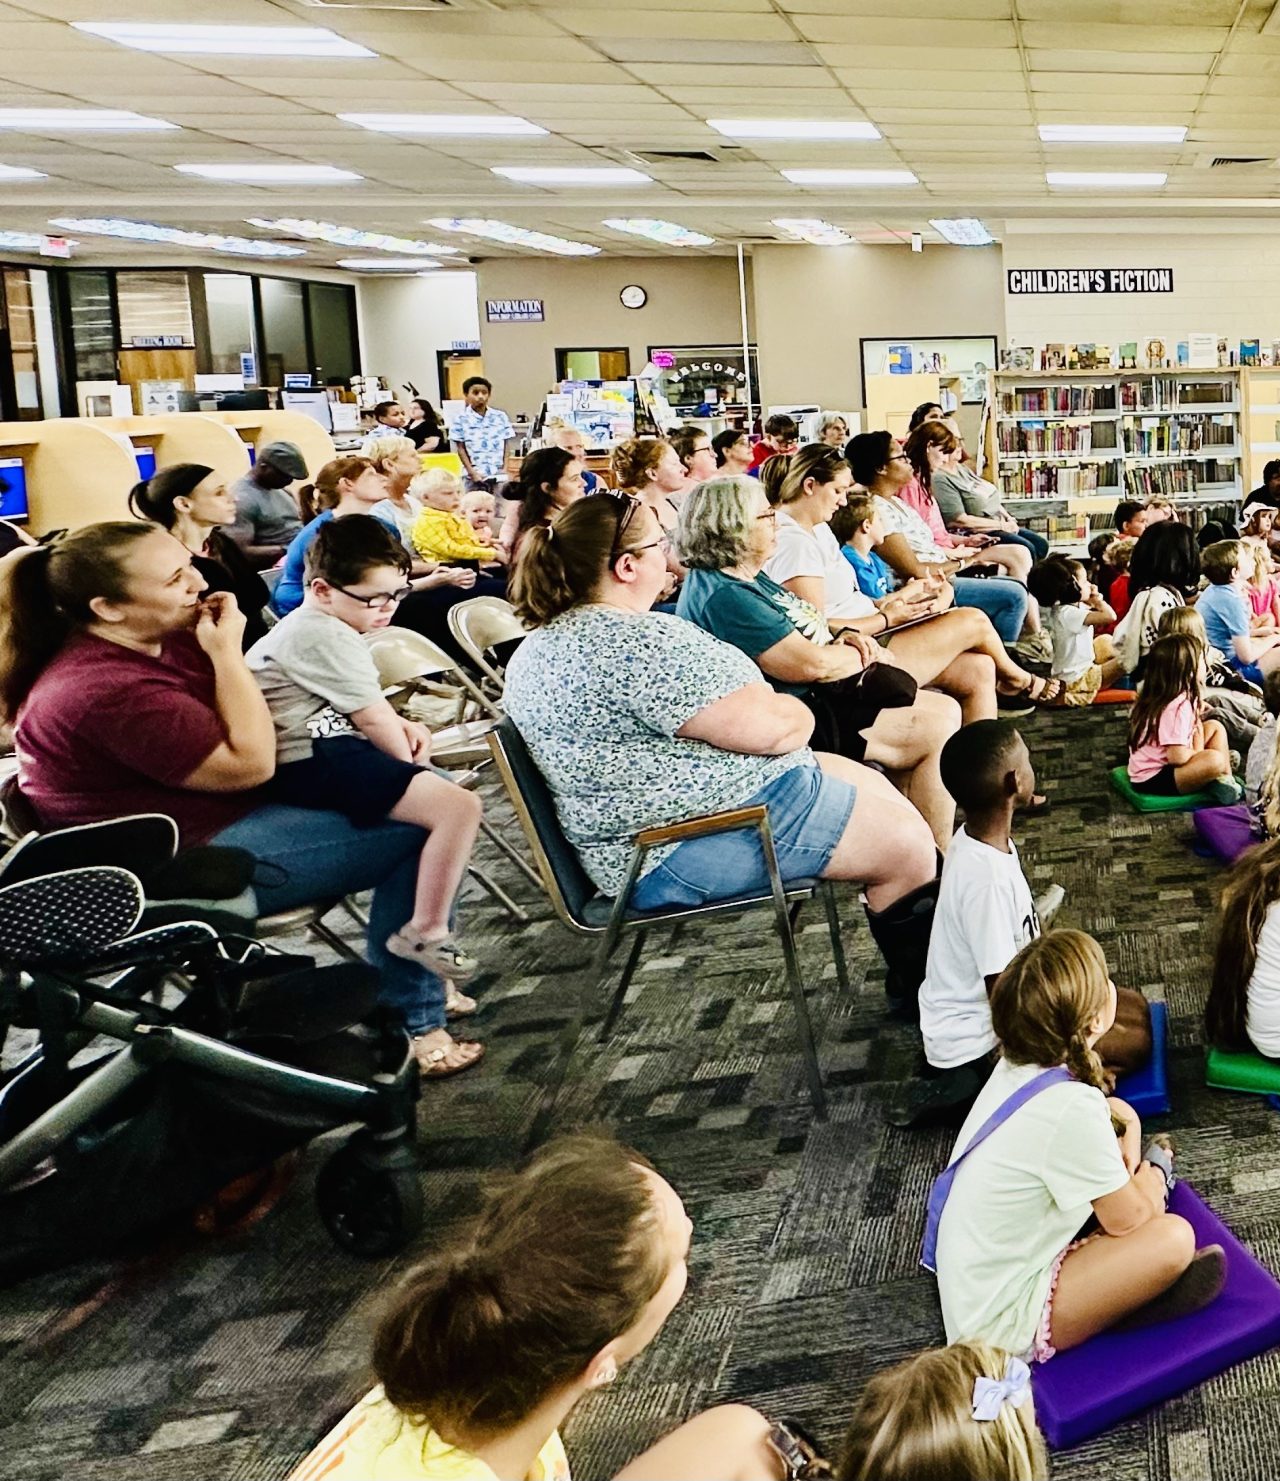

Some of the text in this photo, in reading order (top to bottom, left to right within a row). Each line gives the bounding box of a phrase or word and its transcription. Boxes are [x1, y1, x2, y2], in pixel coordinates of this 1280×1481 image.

[1010, 269, 1170, 293] CHILDREN'S FICTION
[488, 300, 542, 313] INFORMATION
